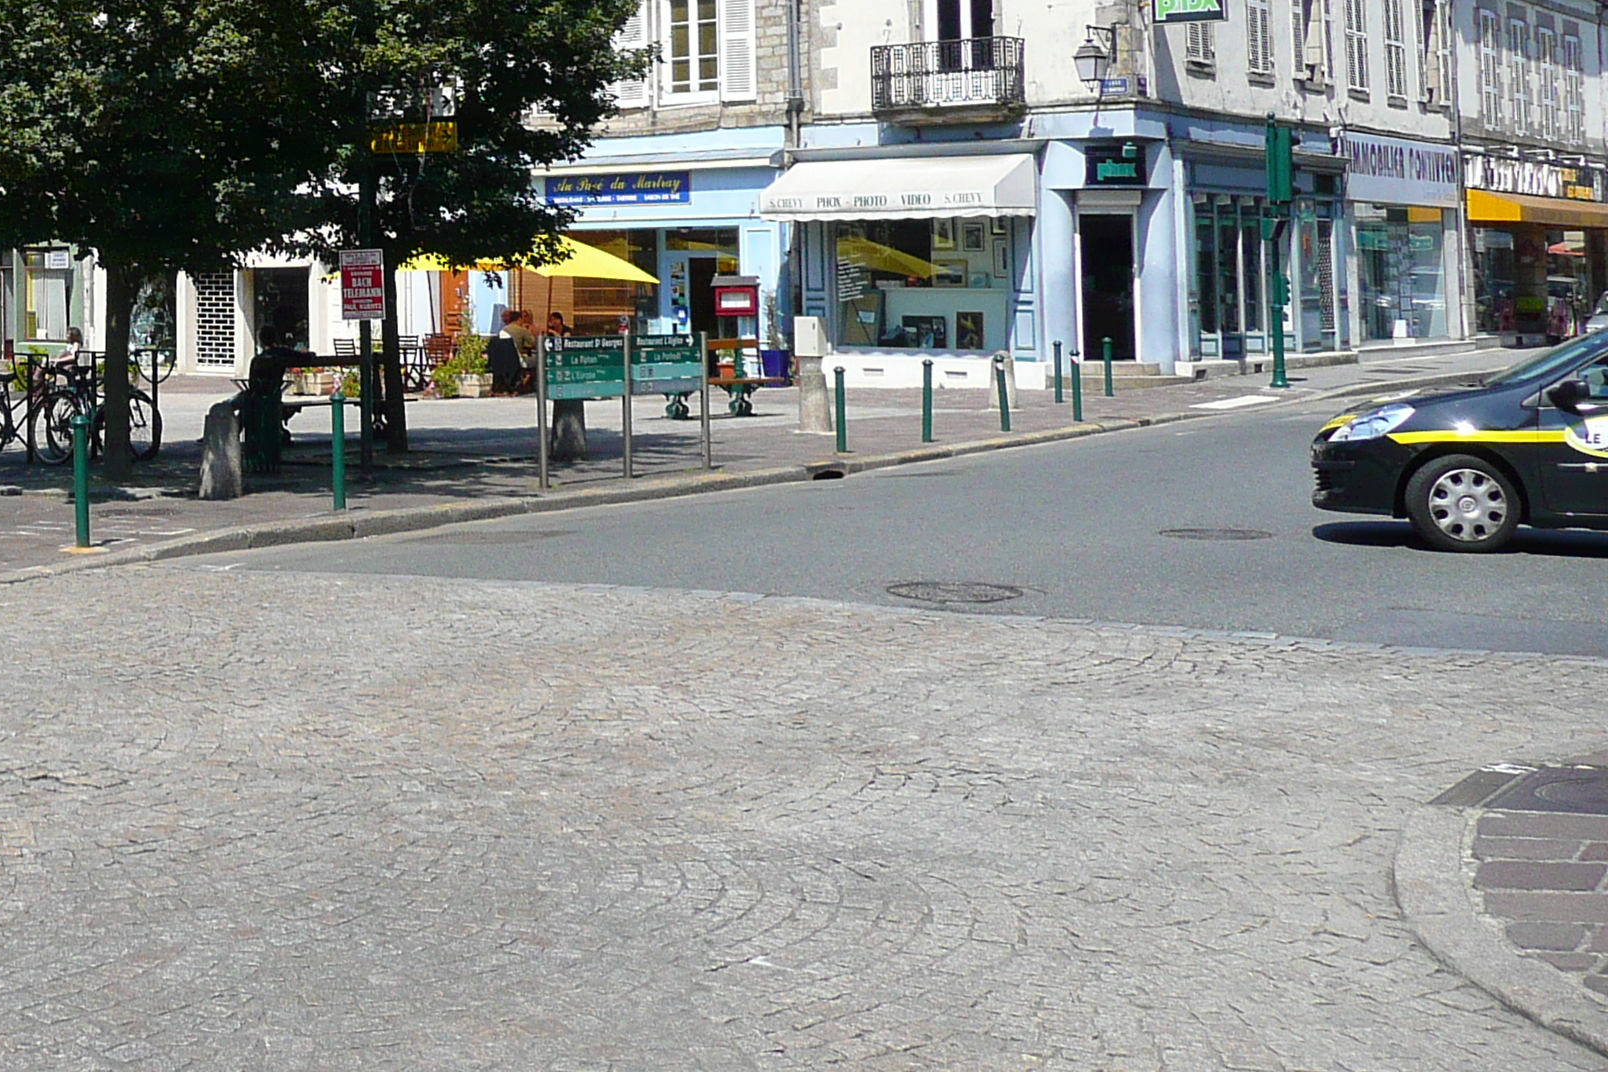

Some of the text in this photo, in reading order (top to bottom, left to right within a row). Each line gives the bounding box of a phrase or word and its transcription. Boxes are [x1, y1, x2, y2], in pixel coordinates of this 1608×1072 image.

[1096, 158, 1137, 181] phox
[610, 176, 625, 190] du
[632, 175, 682, 194] Martray
[816, 197, 841, 208] PHOX
[853, 195, 888, 208] PHOTO
[900, 193, 931, 205] VIDEO
[952, 192, 982, 203] CHEVY
[564, 338, 594, 348] Restaurant
[601, 337, 623, 349] Georges
[1584, 433, 1601, 444] LE
